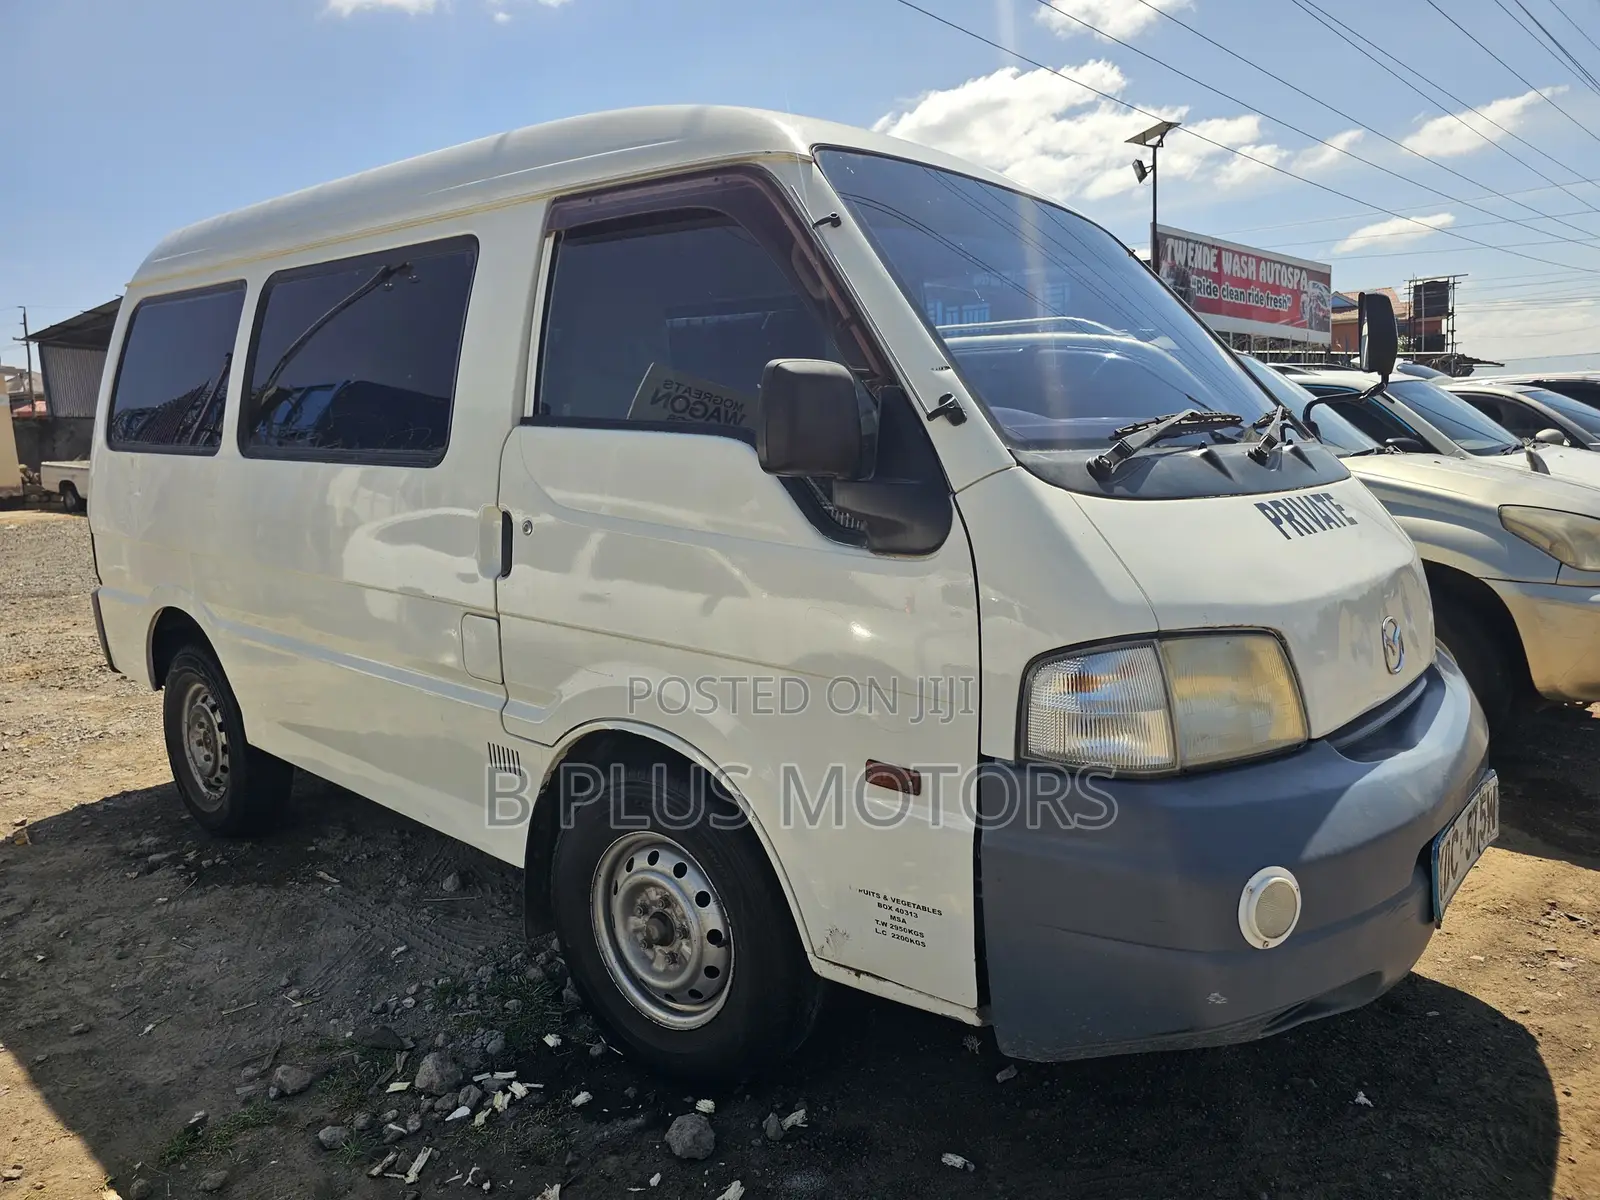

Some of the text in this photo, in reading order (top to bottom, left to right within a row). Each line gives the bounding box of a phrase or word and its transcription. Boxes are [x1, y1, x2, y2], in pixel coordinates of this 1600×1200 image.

[1165, 238, 1308, 291] TWENDE WASH AUTOSPA
[1221, 282, 1246, 303] clean
[1247, 285, 1265, 306] ride
[1254, 492, 1359, 540] PRIVATE
[877, 902, 918, 919] BOX 40313
[890, 896, 943, 916] VEGETABLES
[889, 914, 907, 925] MSA
[889, 923, 925, 938] 2950KGS
[891, 932, 926, 948] 2200KGS
